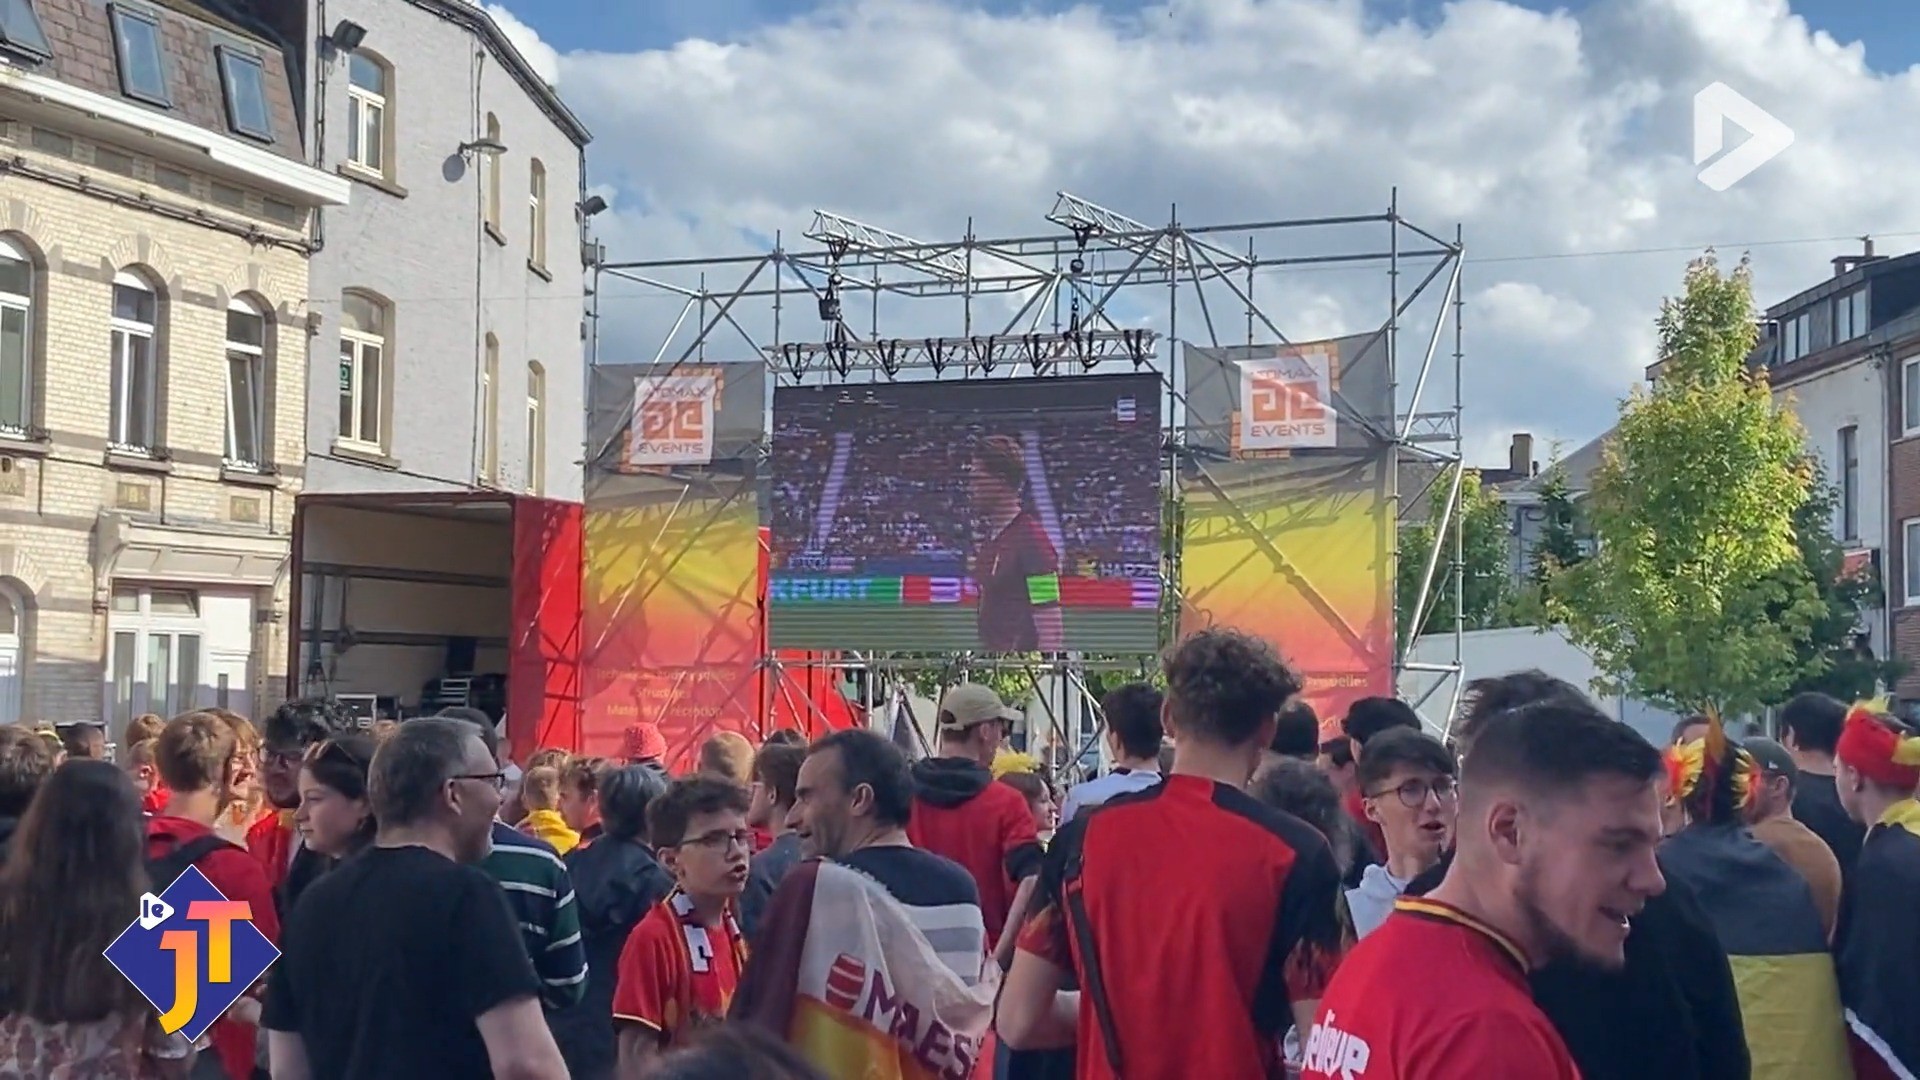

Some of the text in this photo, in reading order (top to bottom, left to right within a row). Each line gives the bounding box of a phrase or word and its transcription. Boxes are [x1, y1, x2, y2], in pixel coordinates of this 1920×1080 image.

[1250, 424, 1326, 437] EVENTS
[638, 442, 704, 454] EVENTS
[863, 968, 973, 1080] MAES
